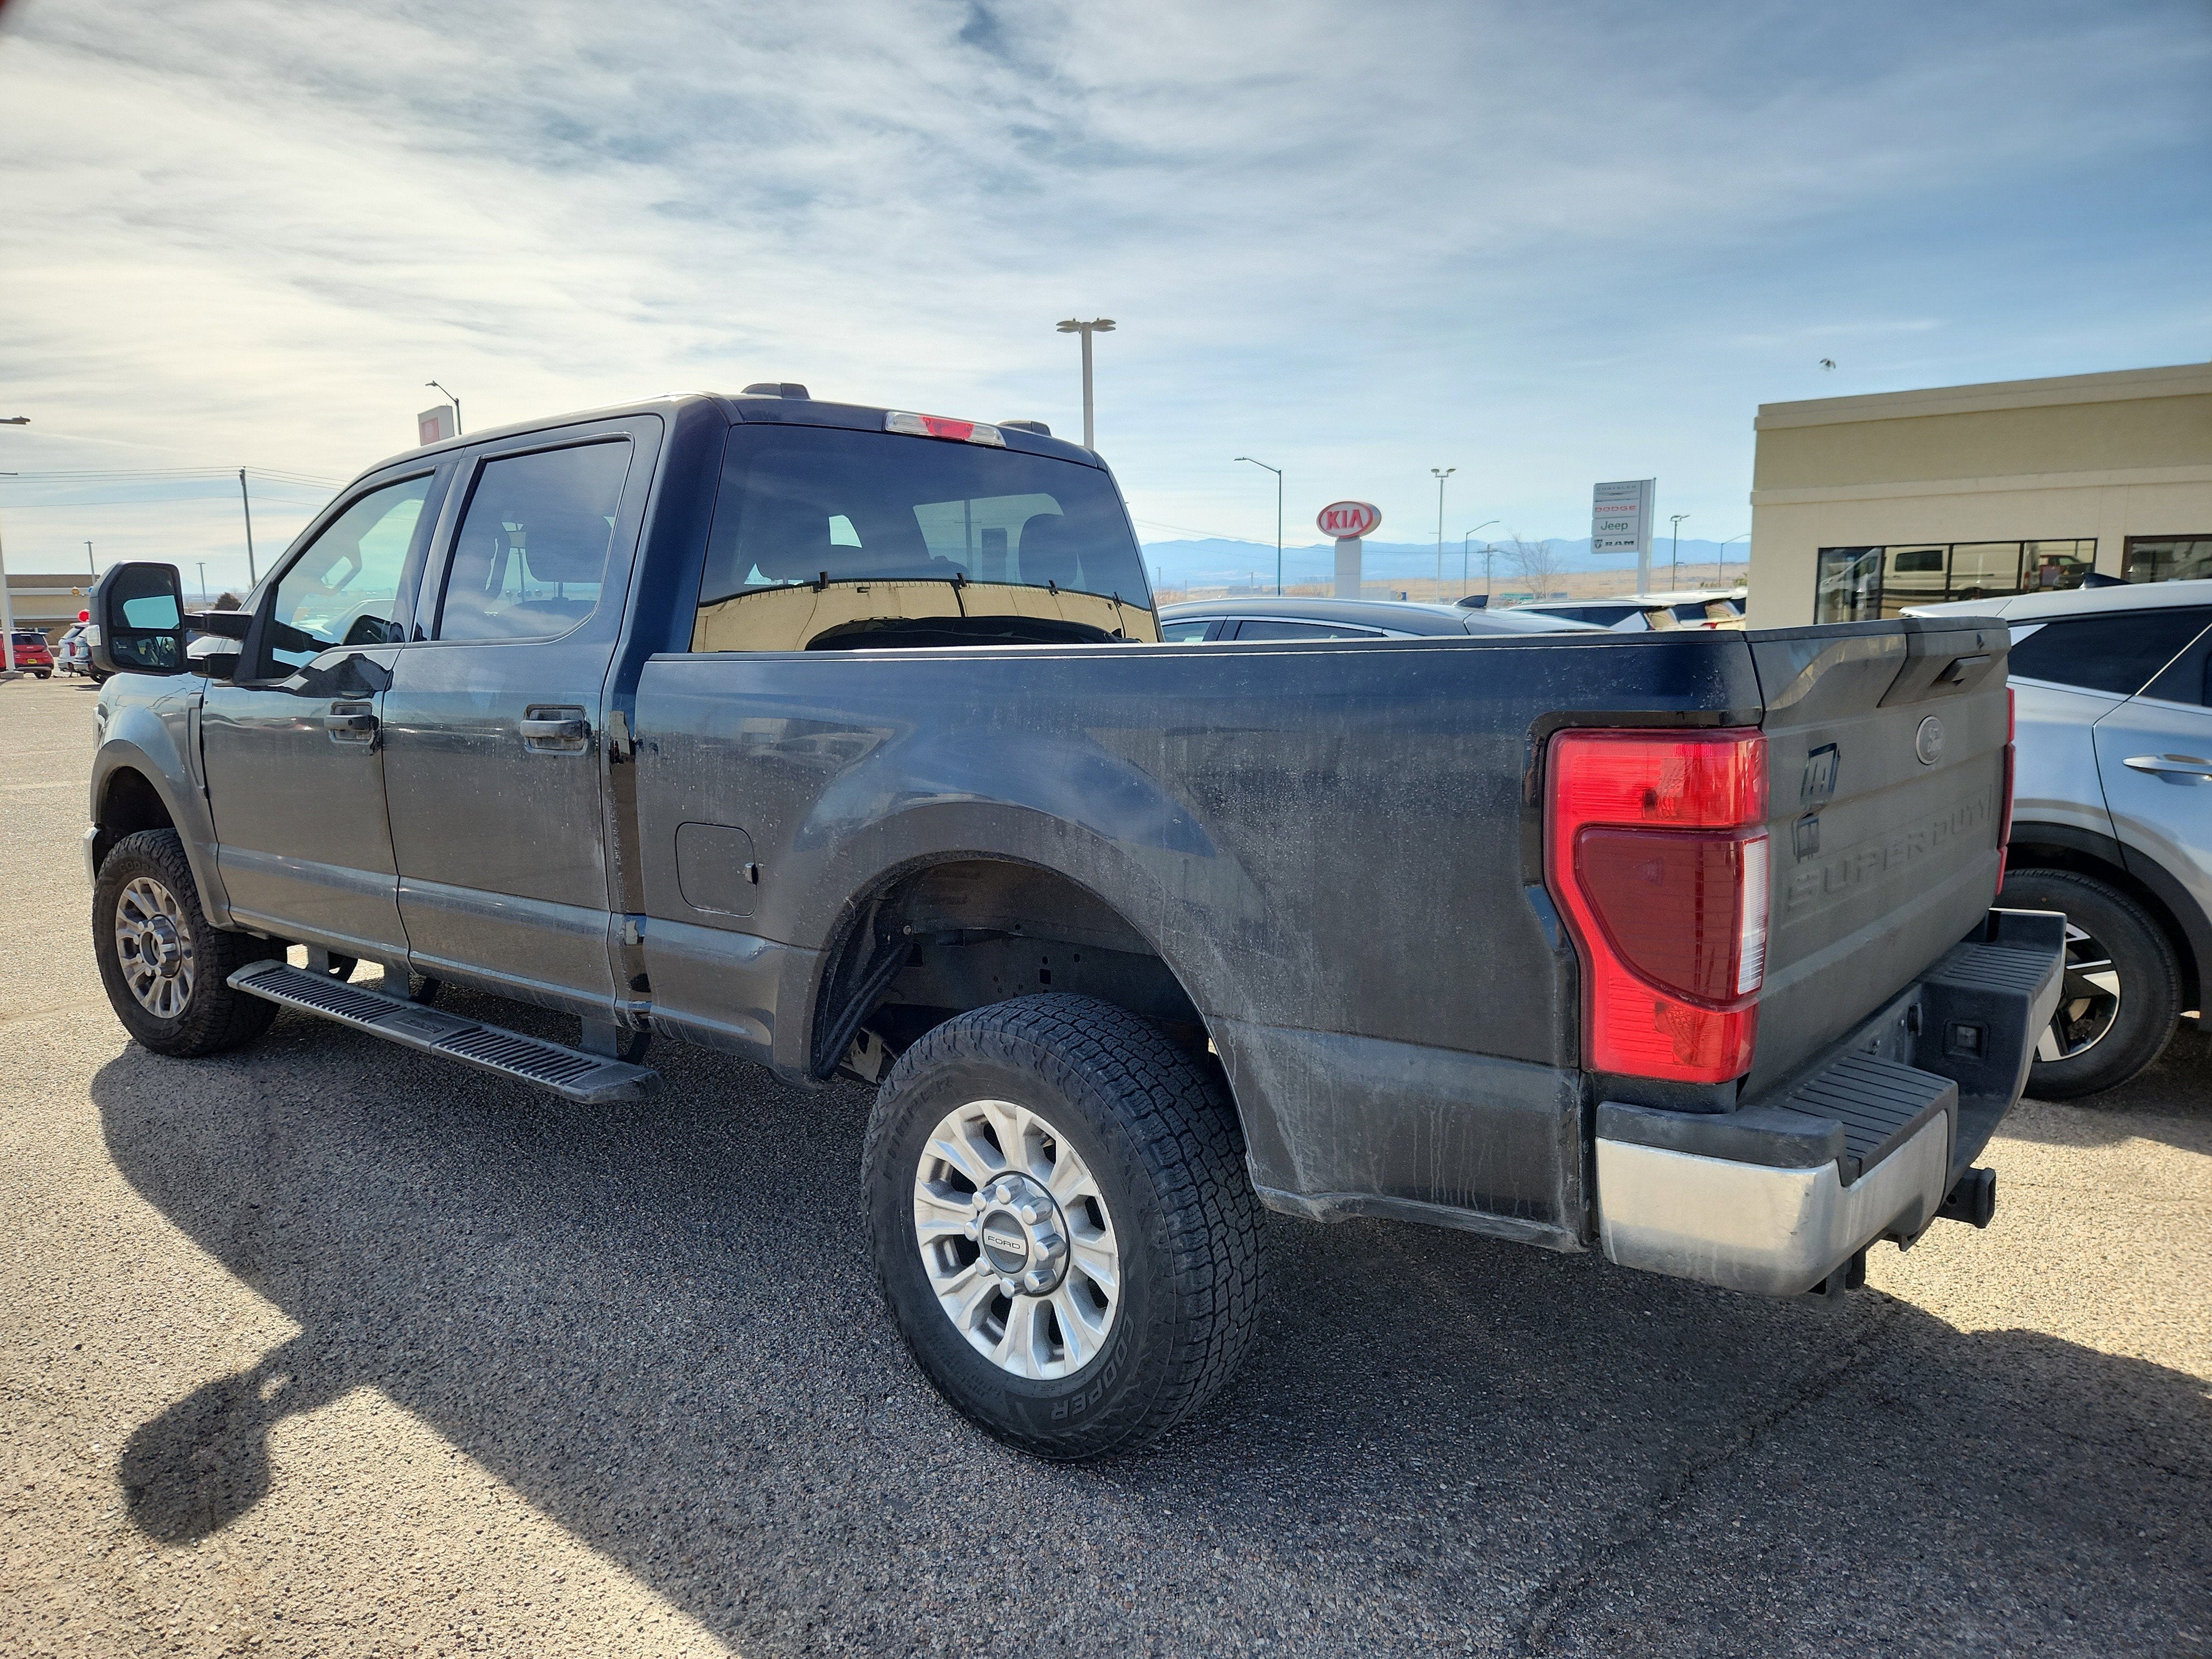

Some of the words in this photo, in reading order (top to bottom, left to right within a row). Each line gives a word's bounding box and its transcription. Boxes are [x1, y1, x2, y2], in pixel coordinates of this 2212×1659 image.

[1326, 509, 1364, 530] KIA
[1600, 521, 1628, 531] Jeep
[988, 1236, 1020, 1250] FORD
[1051, 1312, 1134, 1420] COOPER
